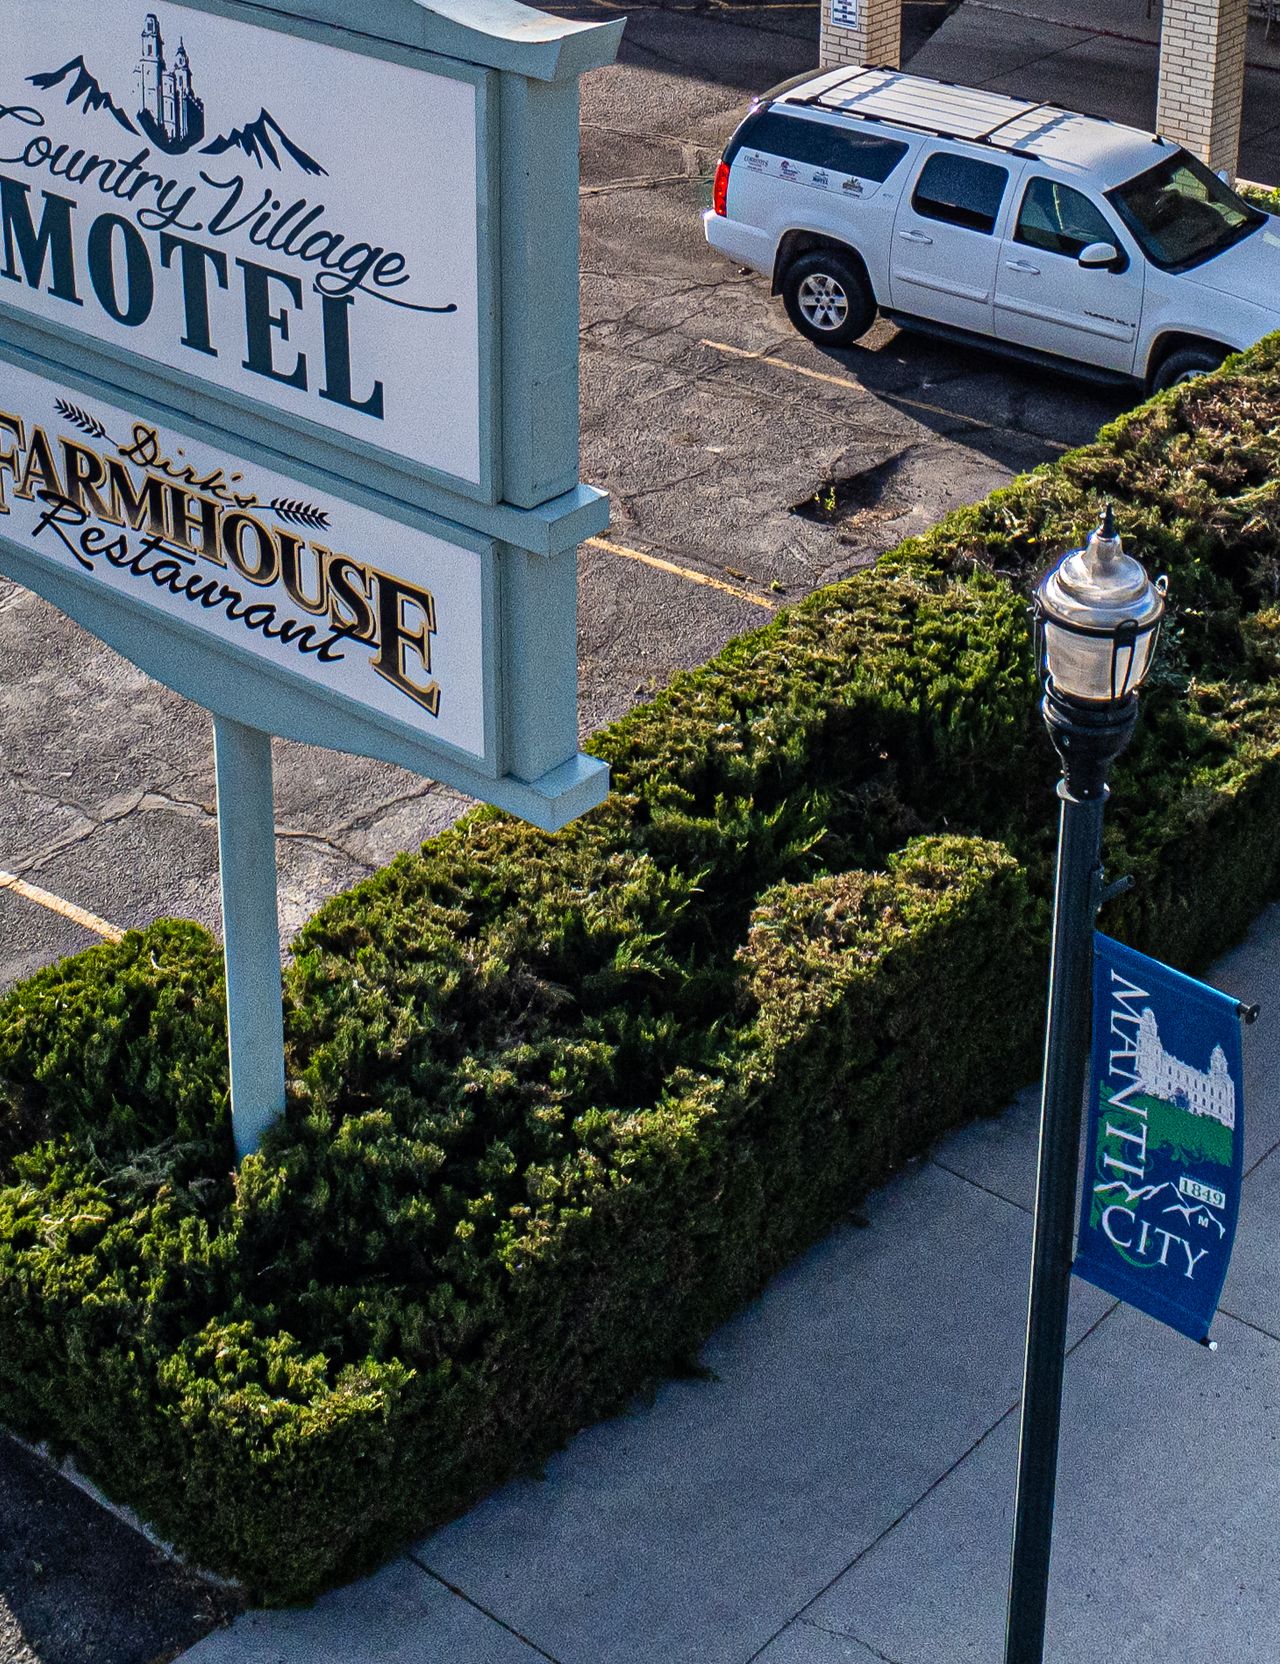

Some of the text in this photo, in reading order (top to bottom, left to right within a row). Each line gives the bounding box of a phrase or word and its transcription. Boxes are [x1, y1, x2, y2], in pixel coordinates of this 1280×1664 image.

[198, 170, 458, 314] Village
[119, 421, 258, 509] Dirk's
[37, 490, 380, 663] Restaurant
[1103, 968, 1151, 1180] MANTI
[1181, 1179, 1223, 1206] 1849
[1197, 1215, 1209, 1228] M
[1101, 1205, 1209, 1280] CITY
